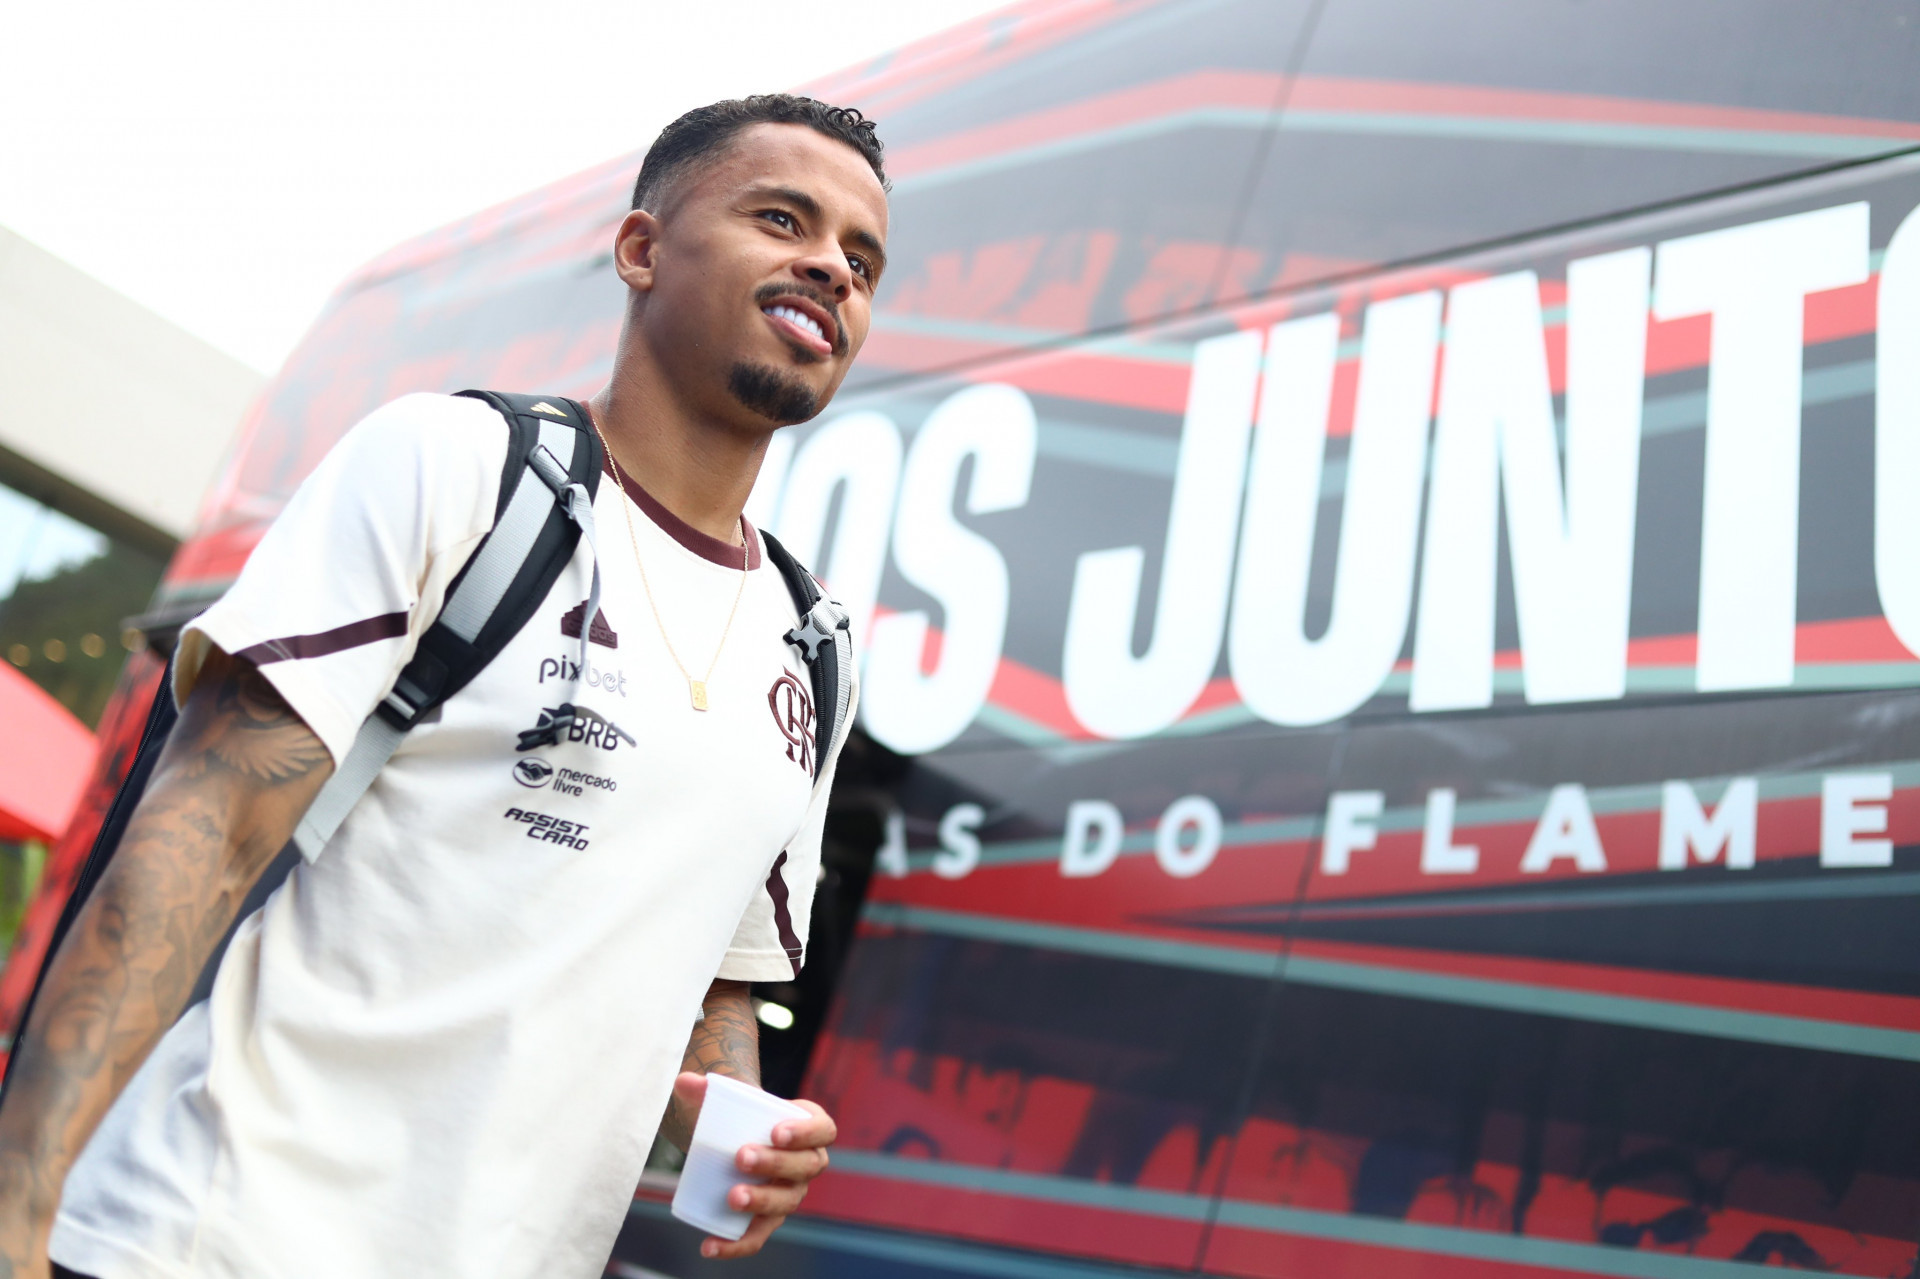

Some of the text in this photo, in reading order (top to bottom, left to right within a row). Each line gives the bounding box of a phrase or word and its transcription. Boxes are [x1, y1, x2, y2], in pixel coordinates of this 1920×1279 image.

[742, 200, 1920, 755] OS JUNT
[539, 654, 627, 698] pixbet
[568, 716, 618, 751] BRB
[552, 778, 584, 797] livre
[558, 767, 617, 792] mercado
[504, 807, 590, 836] ASSIST
[1057, 794, 1224, 878] DO
[1319, 772, 1894, 876] FLAME
[526, 826, 590, 851] CARD
